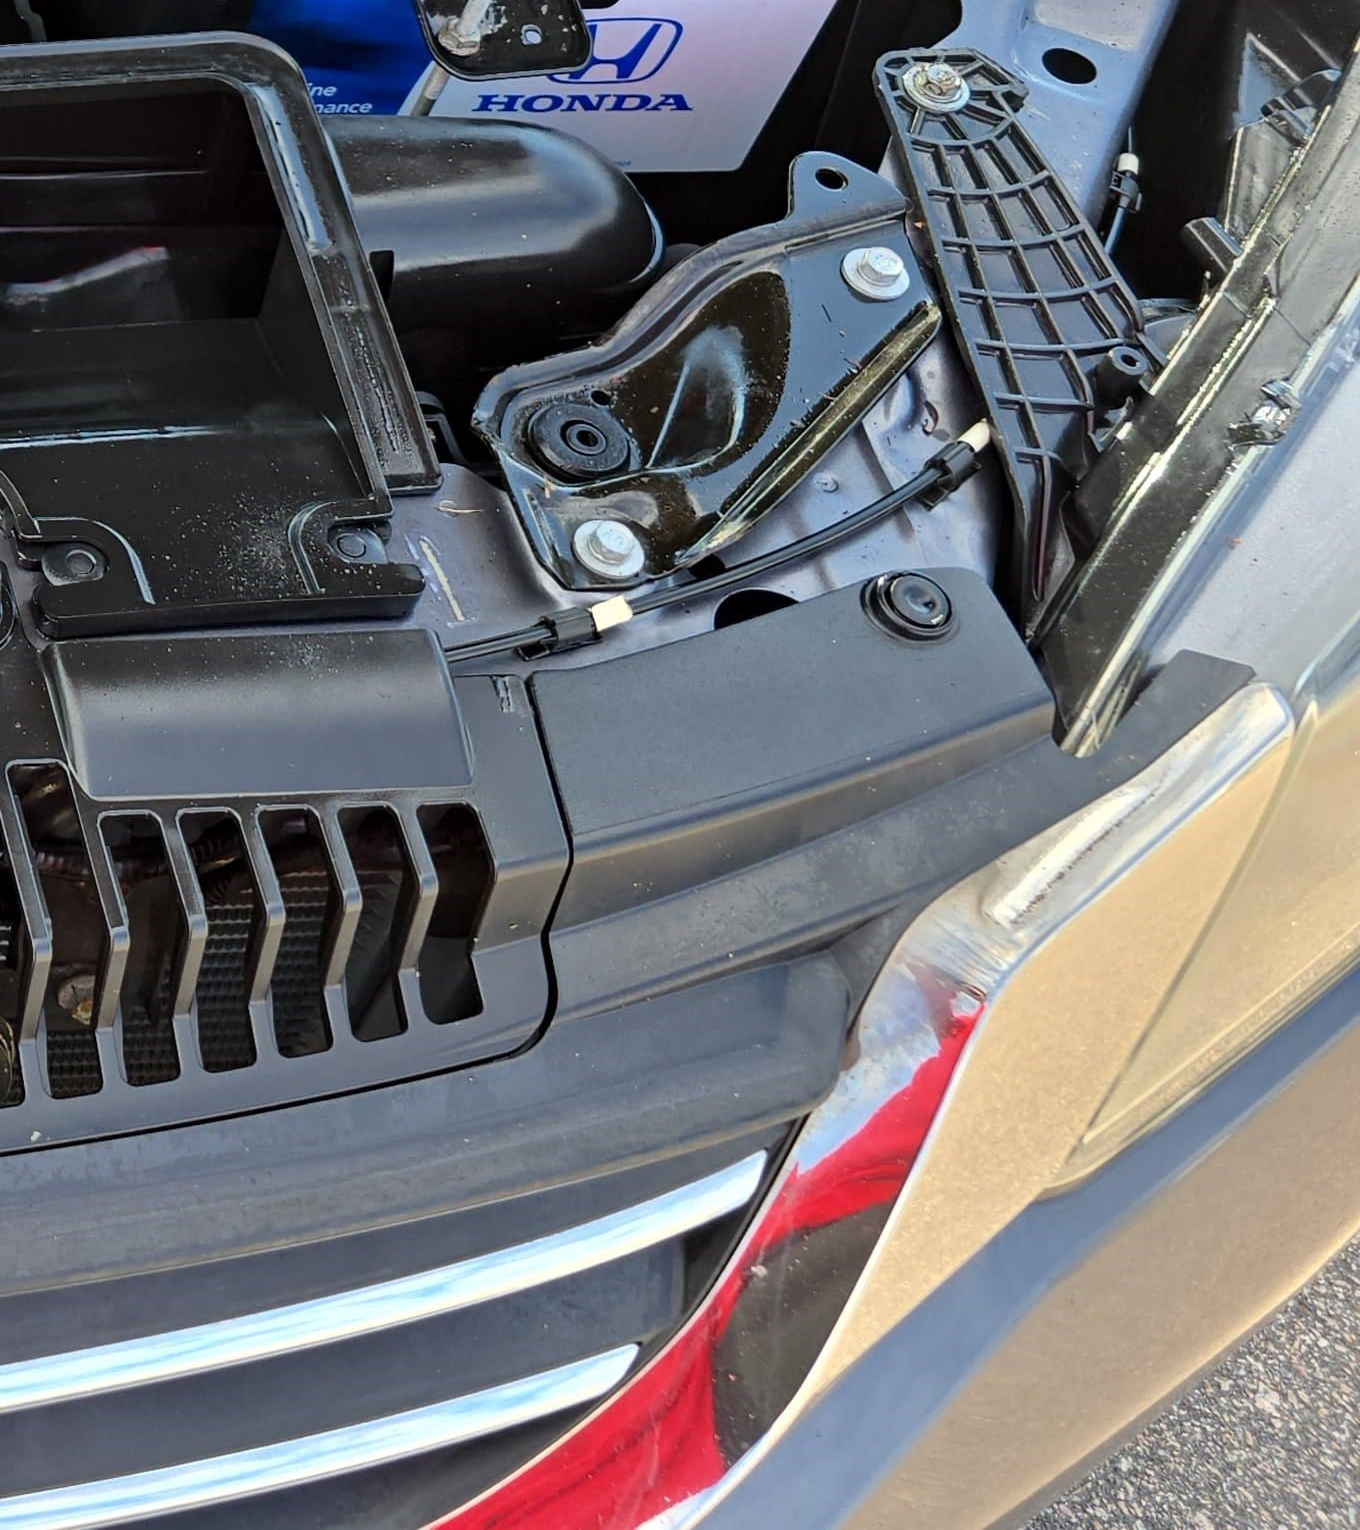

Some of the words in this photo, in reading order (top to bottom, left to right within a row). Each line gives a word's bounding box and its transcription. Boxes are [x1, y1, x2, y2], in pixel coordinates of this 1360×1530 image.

[306, 82, 337, 97] ine
[316, 100, 373, 114] nance
[471, 93, 693, 113] HONDA
